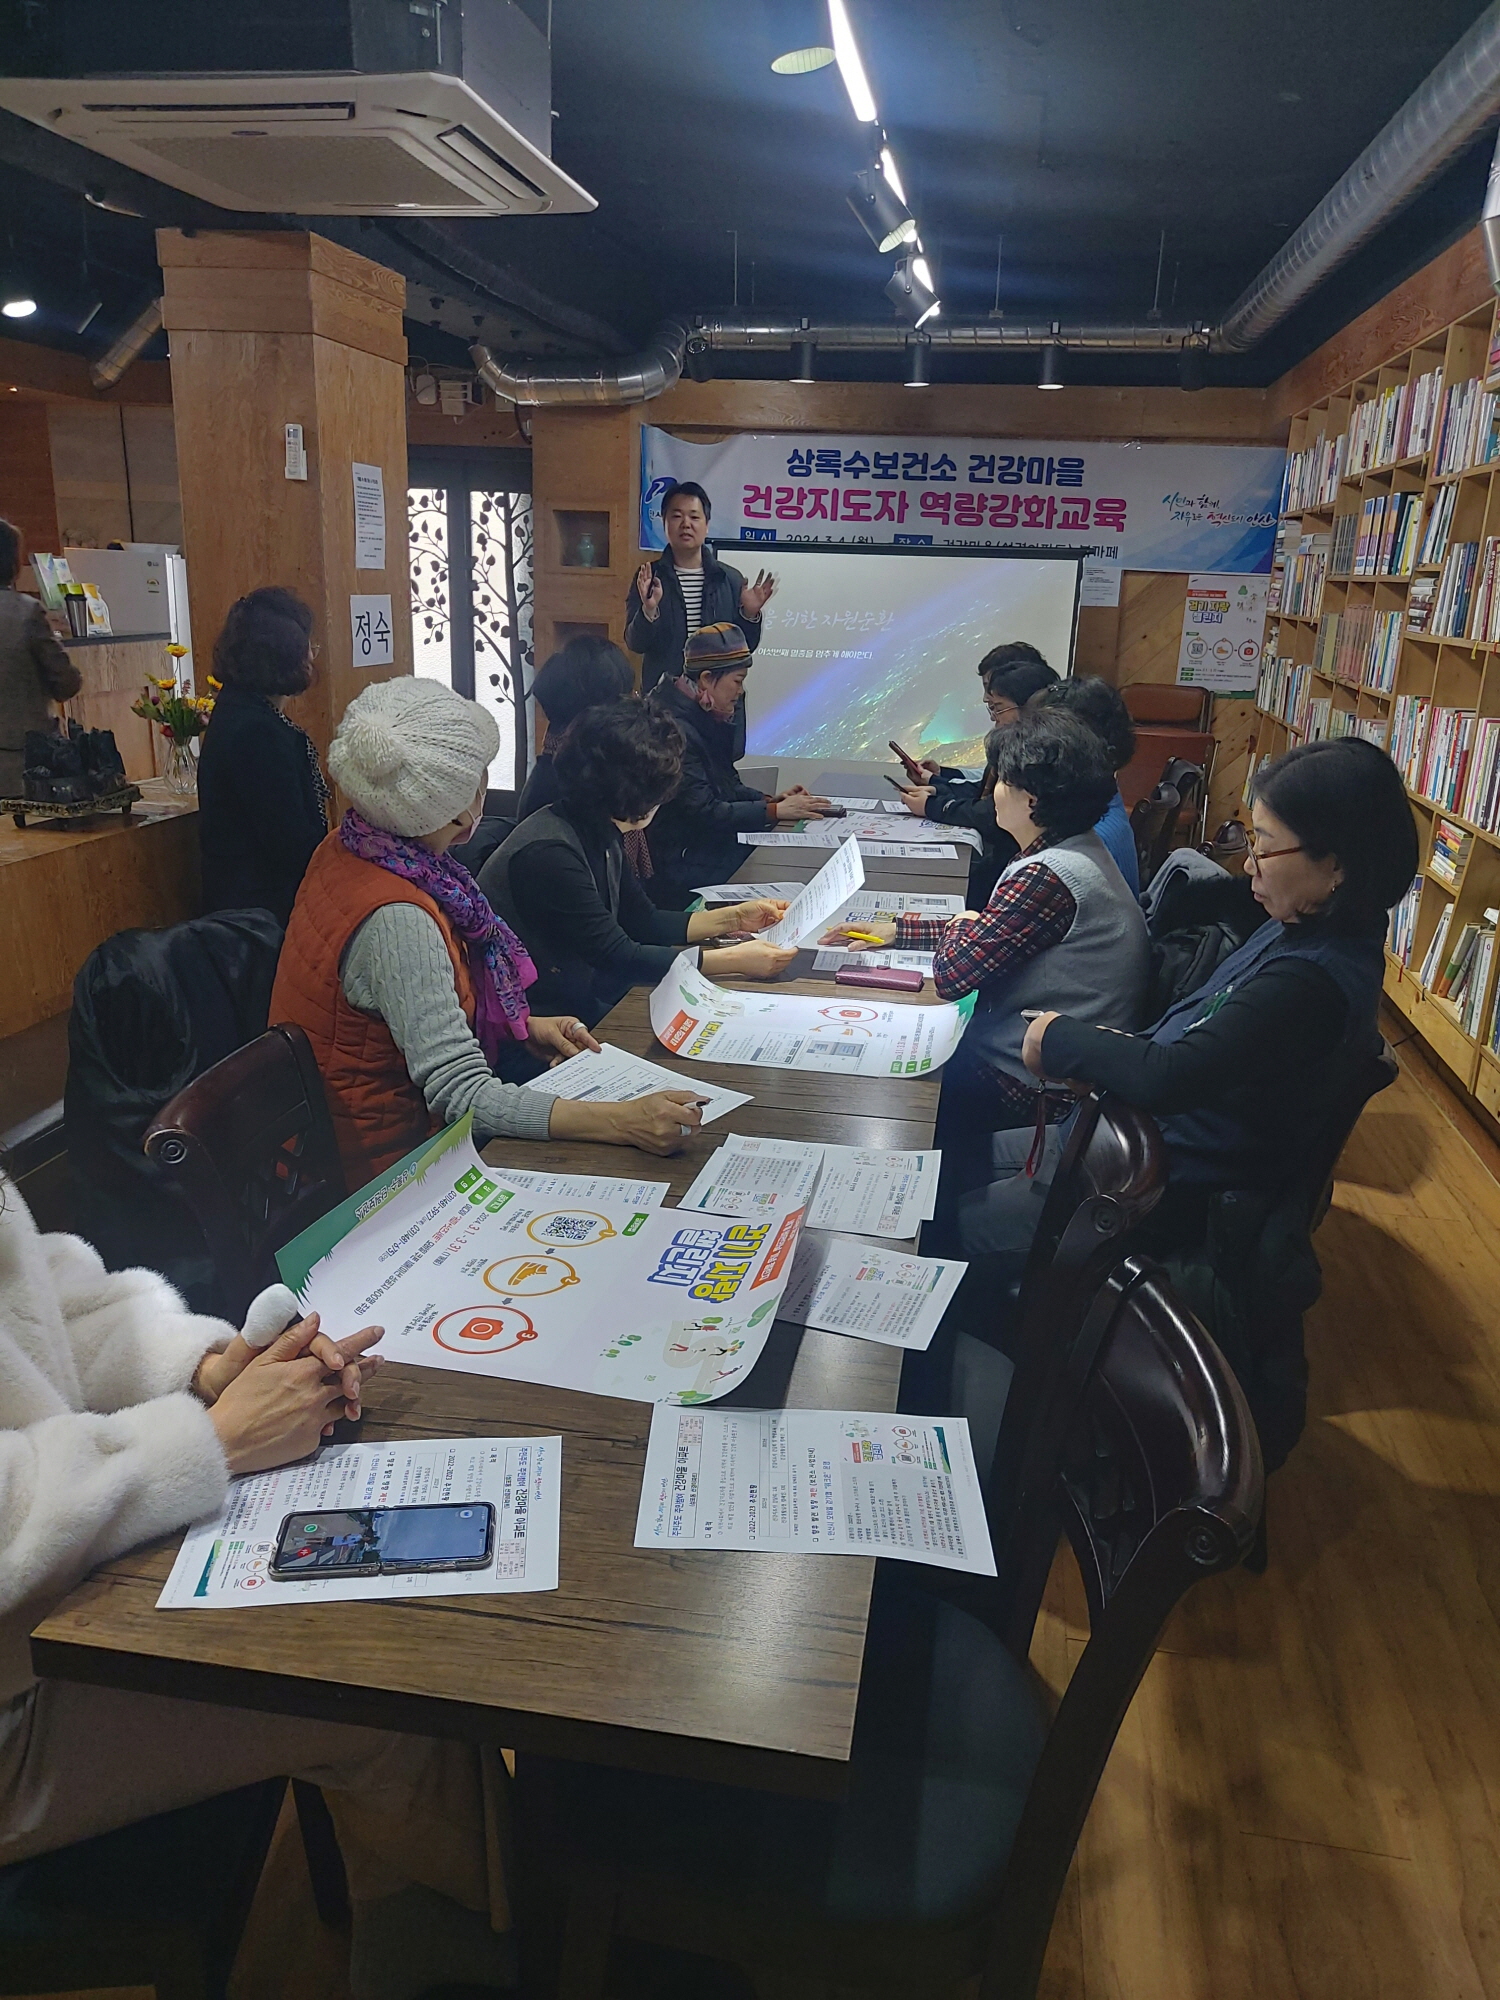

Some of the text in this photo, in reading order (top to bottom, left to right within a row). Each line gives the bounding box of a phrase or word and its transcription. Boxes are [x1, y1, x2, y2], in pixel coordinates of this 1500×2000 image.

[787, 449, 1085, 487] 상록수보건소 건강마을
[742, 485, 1127, 532] 건강지도자 역량강화교육
[1246, 513, 1276, 527] 안산
[355, 610, 391, 656] 정숙
[780, 608, 818, 630] 위한
[712, 1223, 772, 1259] 걷기
[647, 1229, 722, 1286] 챌린지
[366, 1288, 385, 1305] 400명
[688, 1261, 752, 1303] 자랑
[371, 1458, 379, 1471] 안산시
[807, 1447, 816, 1468] 사업안내)
[367, 1473, 376, 1485] 모바일
[513, 1448, 528, 1539] 주민주도 주민참여 건강마을 아파트
[672, 1445, 689, 1536] 주민주도 주민참여 건강마을 아파트
[749, 1484, 758, 1503] 추진현황
[827, 1521, 835, 1536] 안산시
